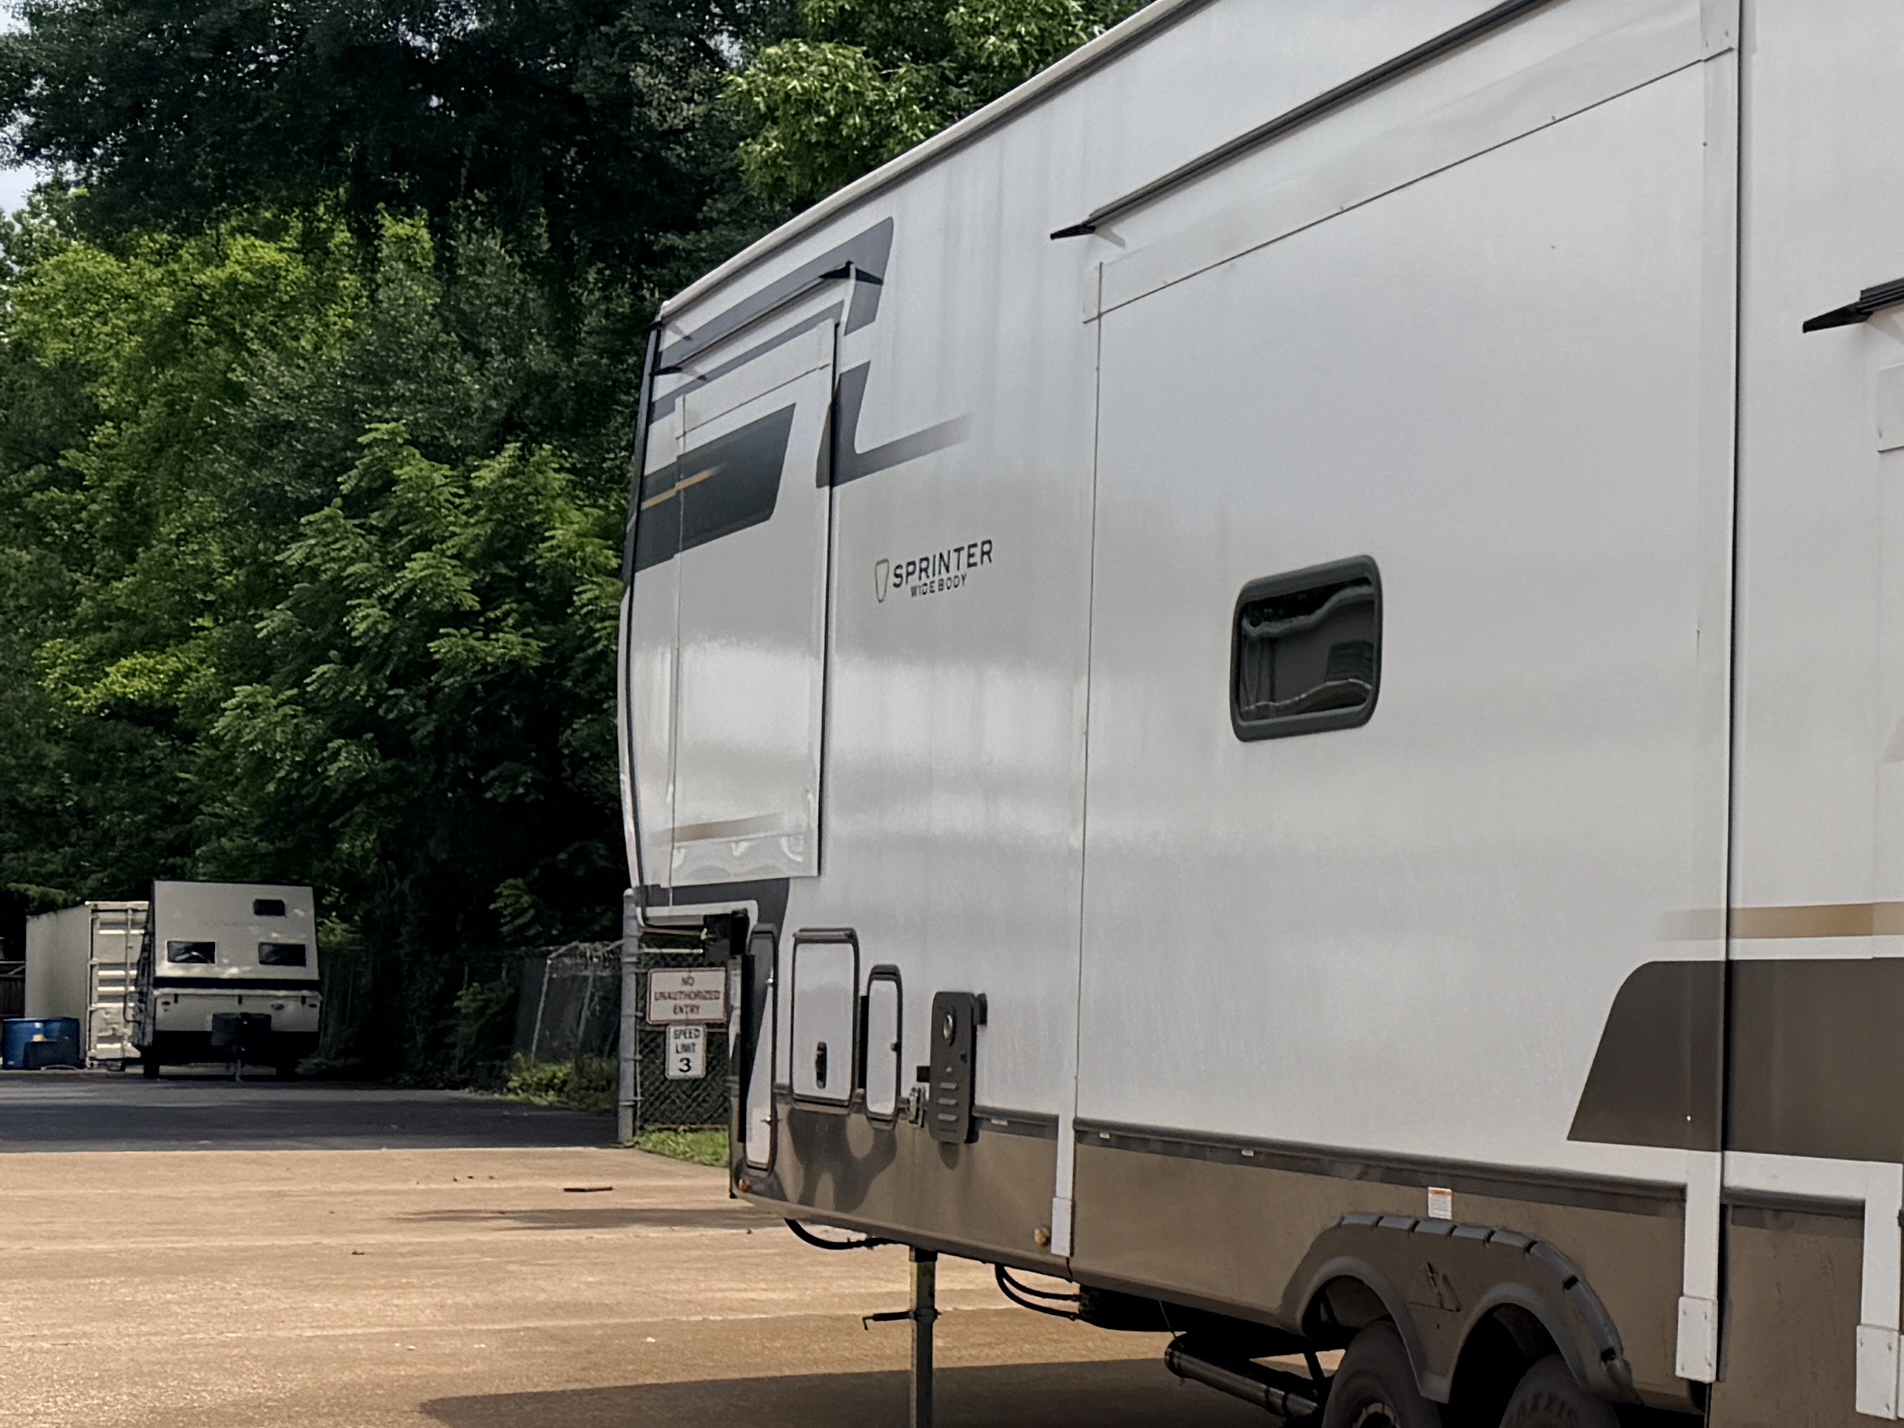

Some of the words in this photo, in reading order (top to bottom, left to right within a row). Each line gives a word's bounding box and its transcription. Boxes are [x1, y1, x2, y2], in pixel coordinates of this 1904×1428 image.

[892, 538, 994, 589] SPRINTER
[681, 976, 695, 987] NO
[673, 1004, 699, 1014] ENTRY
[673, 1028, 700, 1039] SPEED
[678, 1056, 692, 1073] 3
